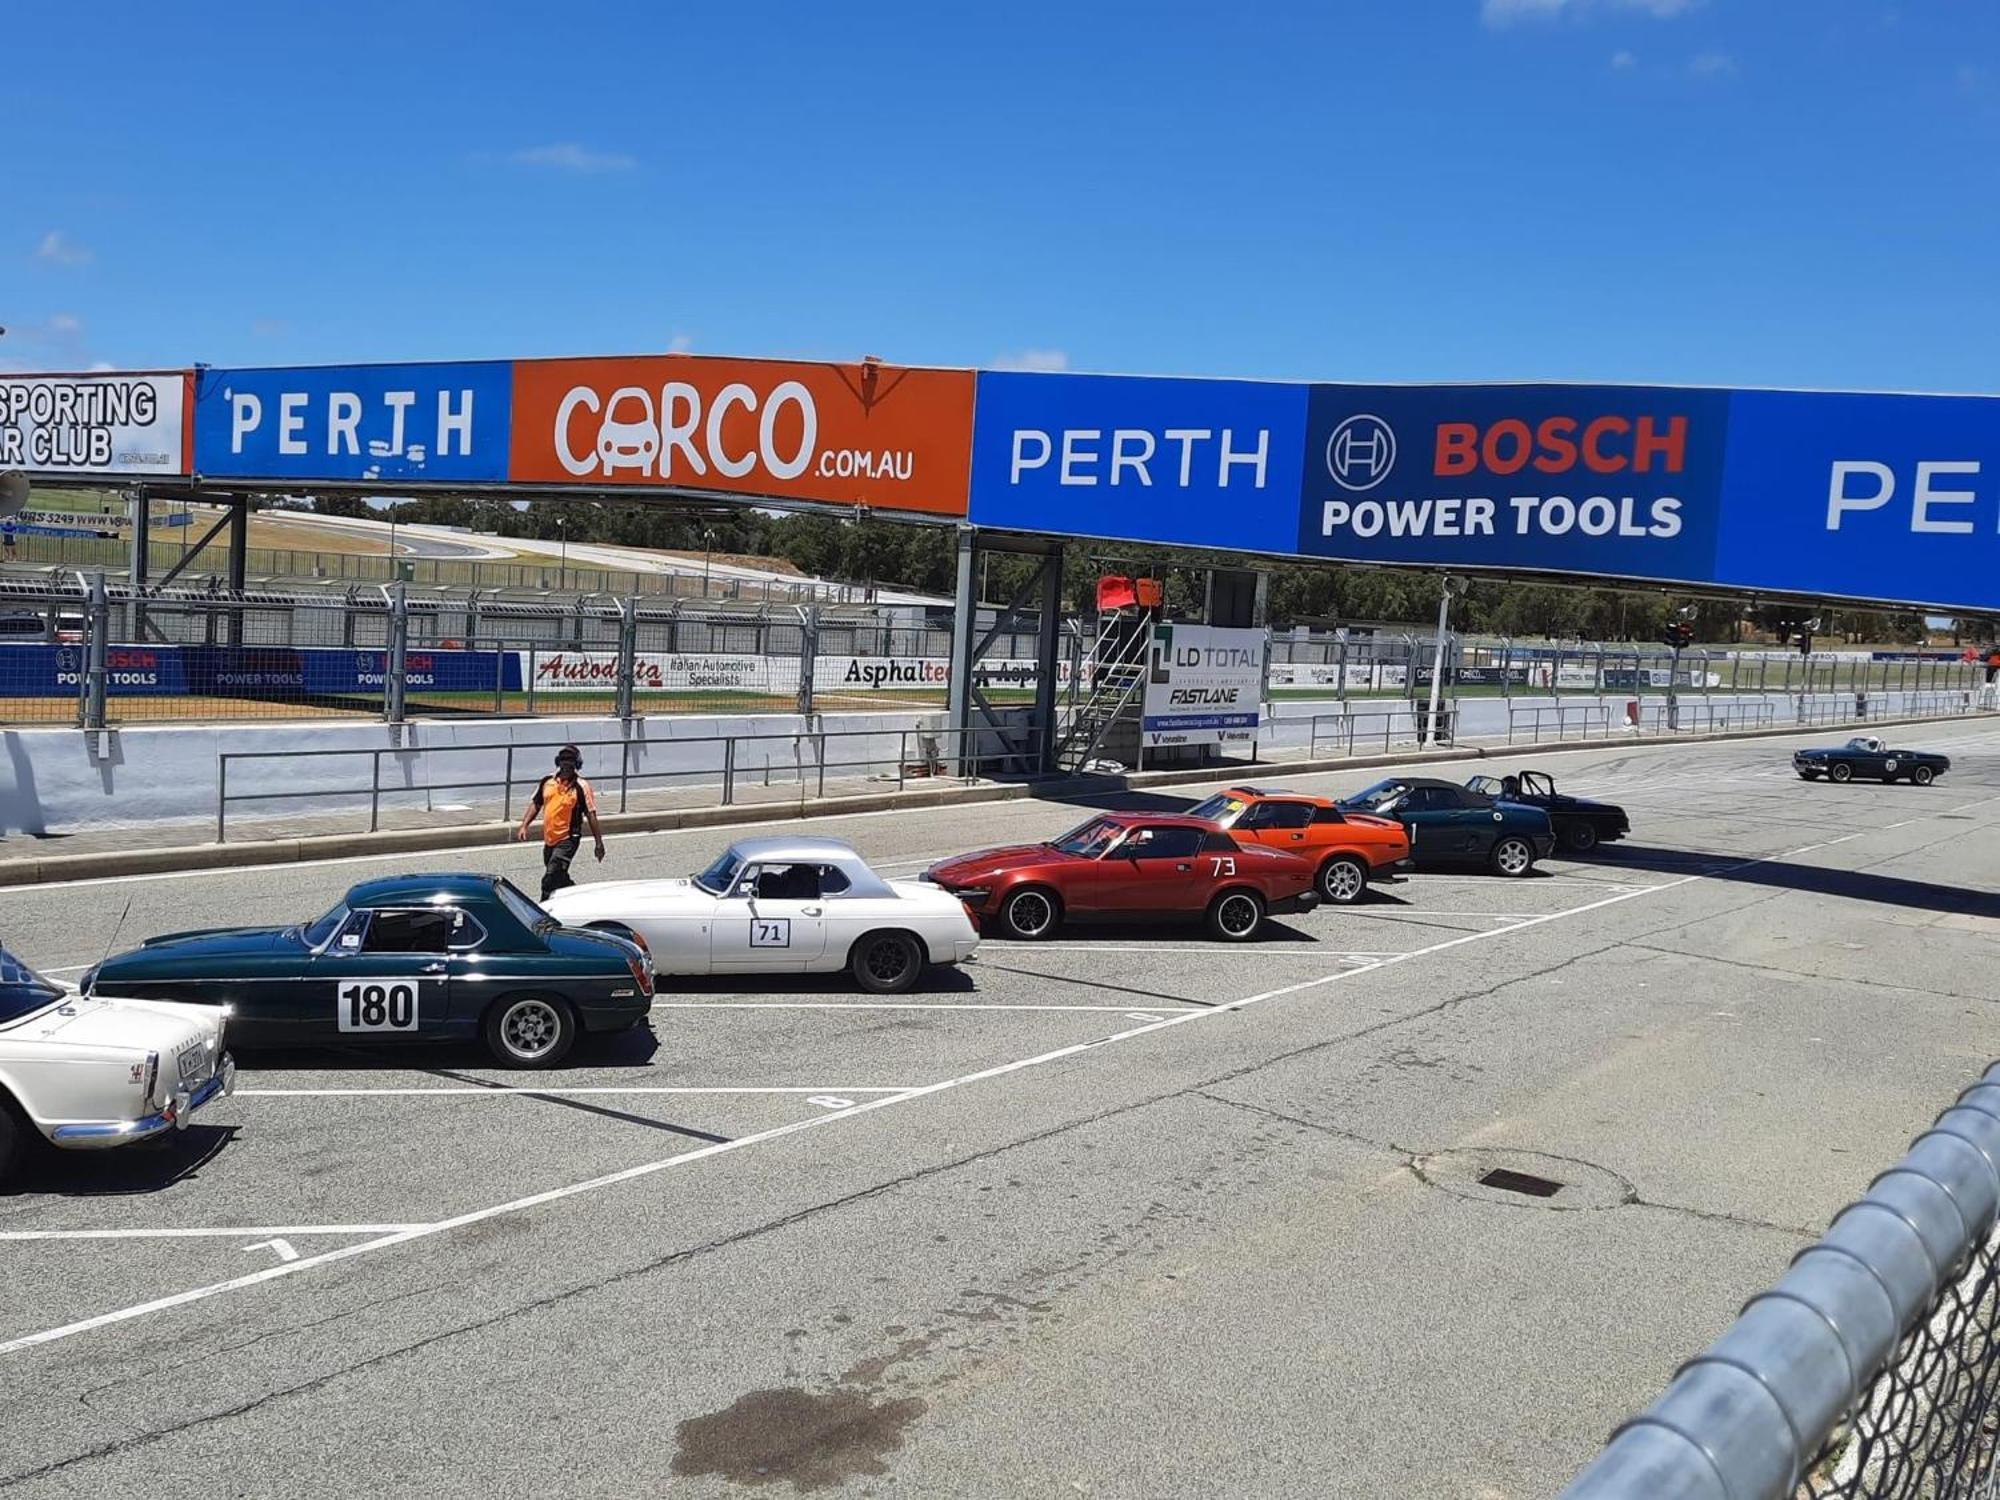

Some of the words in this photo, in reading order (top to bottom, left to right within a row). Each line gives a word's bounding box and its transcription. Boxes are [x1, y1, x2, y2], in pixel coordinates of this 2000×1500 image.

[231, 390, 473, 457] PERTH
[0, 426, 25, 465] R
[30, 426, 112, 465] CLUB
[1010, 429, 1269, 488] PERTH
[1434, 416, 1688, 476] BOSCH
[1826, 460, 2000, 534] PE
[1322, 499, 1494, 537] POWER
[1511, 497, 1682, 538] TOOLS
[702, 659, 756, 672] Automotive
[1177, 648, 1200, 667] LD
[1203, 649, 1260, 667] TOTAL
[112, 673, 157, 685] TOOLS
[406, 674, 434, 684] OOLS
[1169, 689, 1239, 704] FASTLANE
[1210, 857, 1235, 877] 73
[759, 925, 781, 941] 71
[343, 985, 413, 1028] 180
